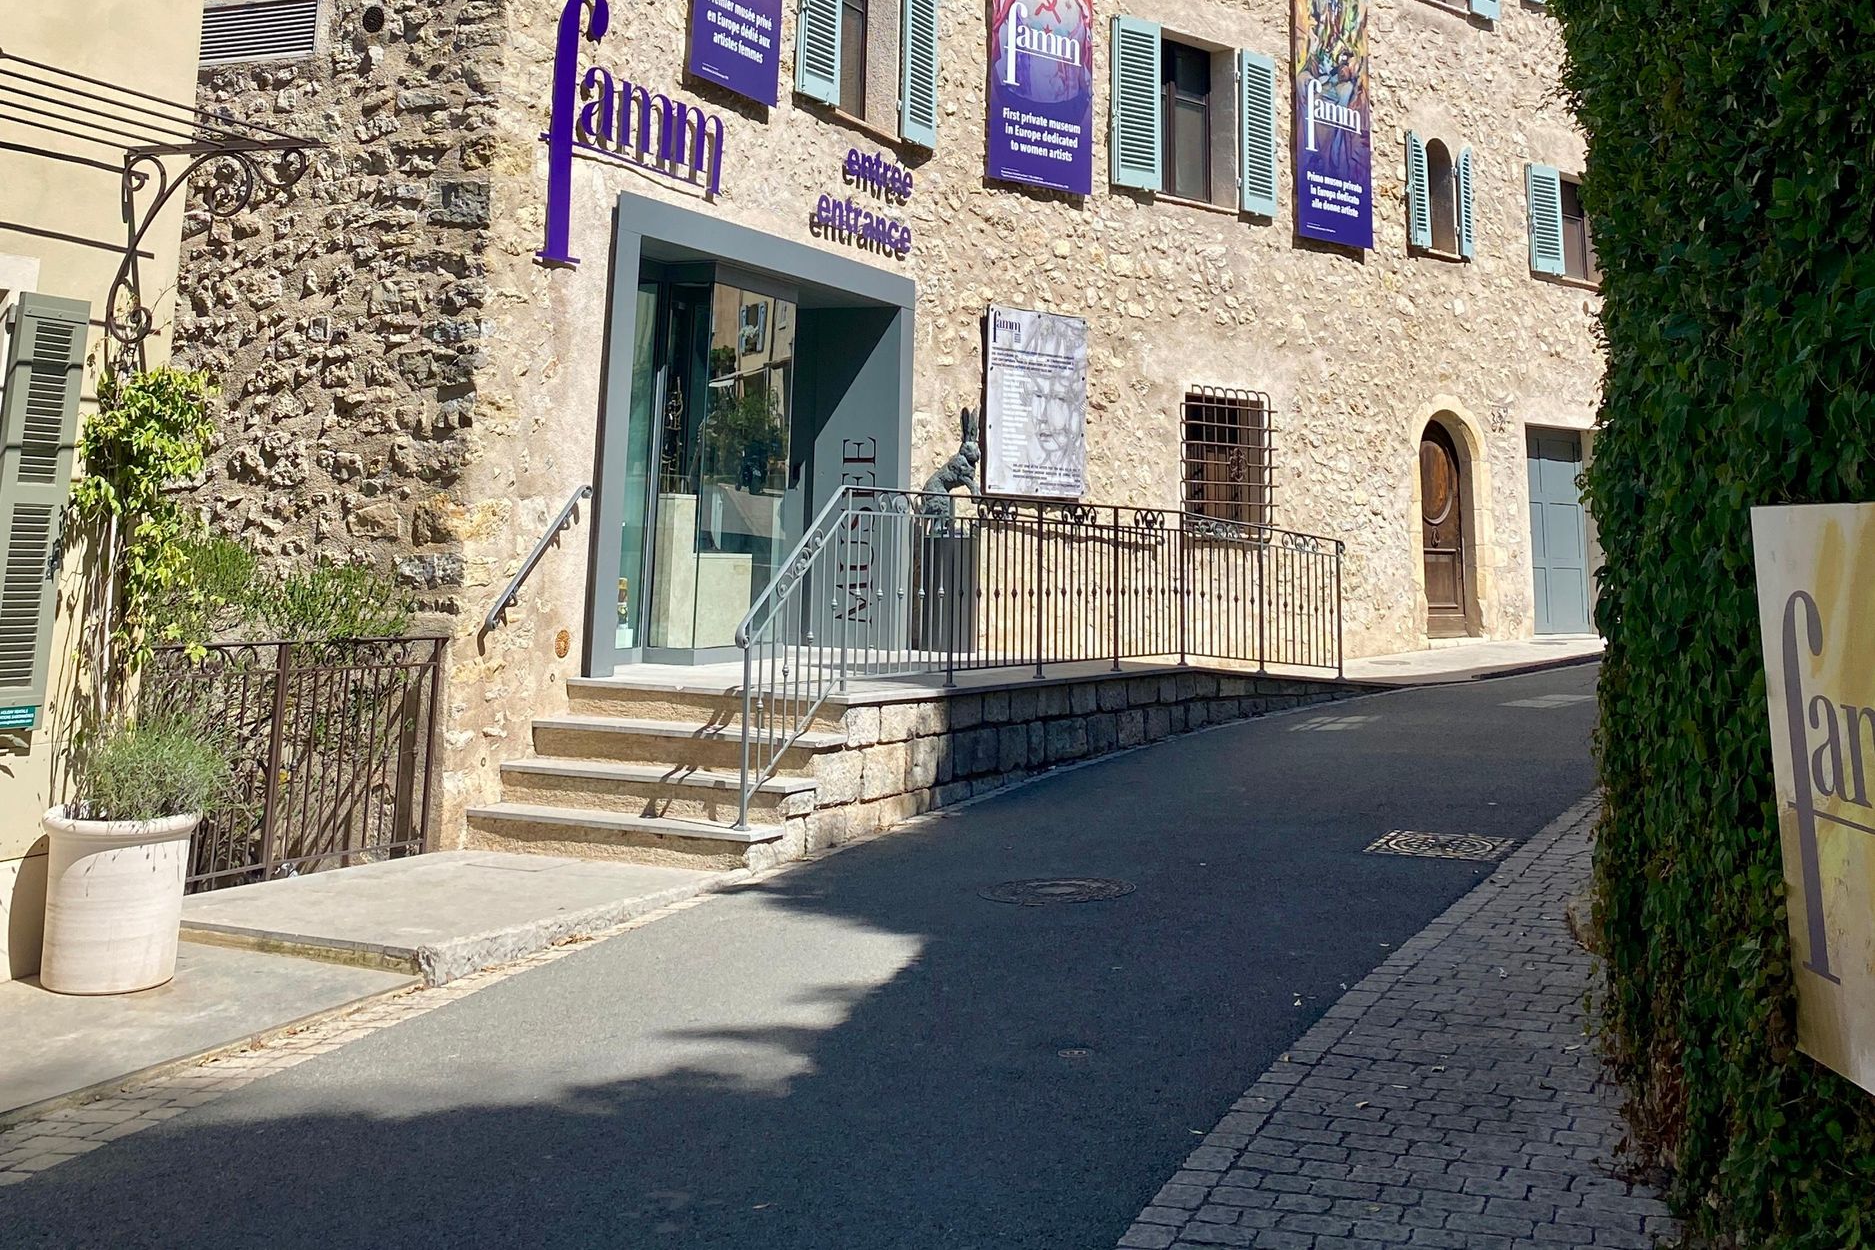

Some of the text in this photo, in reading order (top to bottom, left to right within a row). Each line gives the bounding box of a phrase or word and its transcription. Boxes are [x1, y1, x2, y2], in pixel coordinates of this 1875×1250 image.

[707, 10, 771, 49] en Europe dédié aux
[734, 4, 755, 23] musée
[755, 14, 772, 31] privé
[713, 31, 763, 64] artistes femmes
[1003, 2, 1082, 86] famm
[1003, 107, 1081, 135] First private museum
[1305, 79, 1362, 152] famm
[1005, 122, 1078, 149] in Europe dedicated
[1010, 139, 1073, 162] to women artists
[817, 194, 911, 255] entrance
[992, 310, 1021, 343] famm
